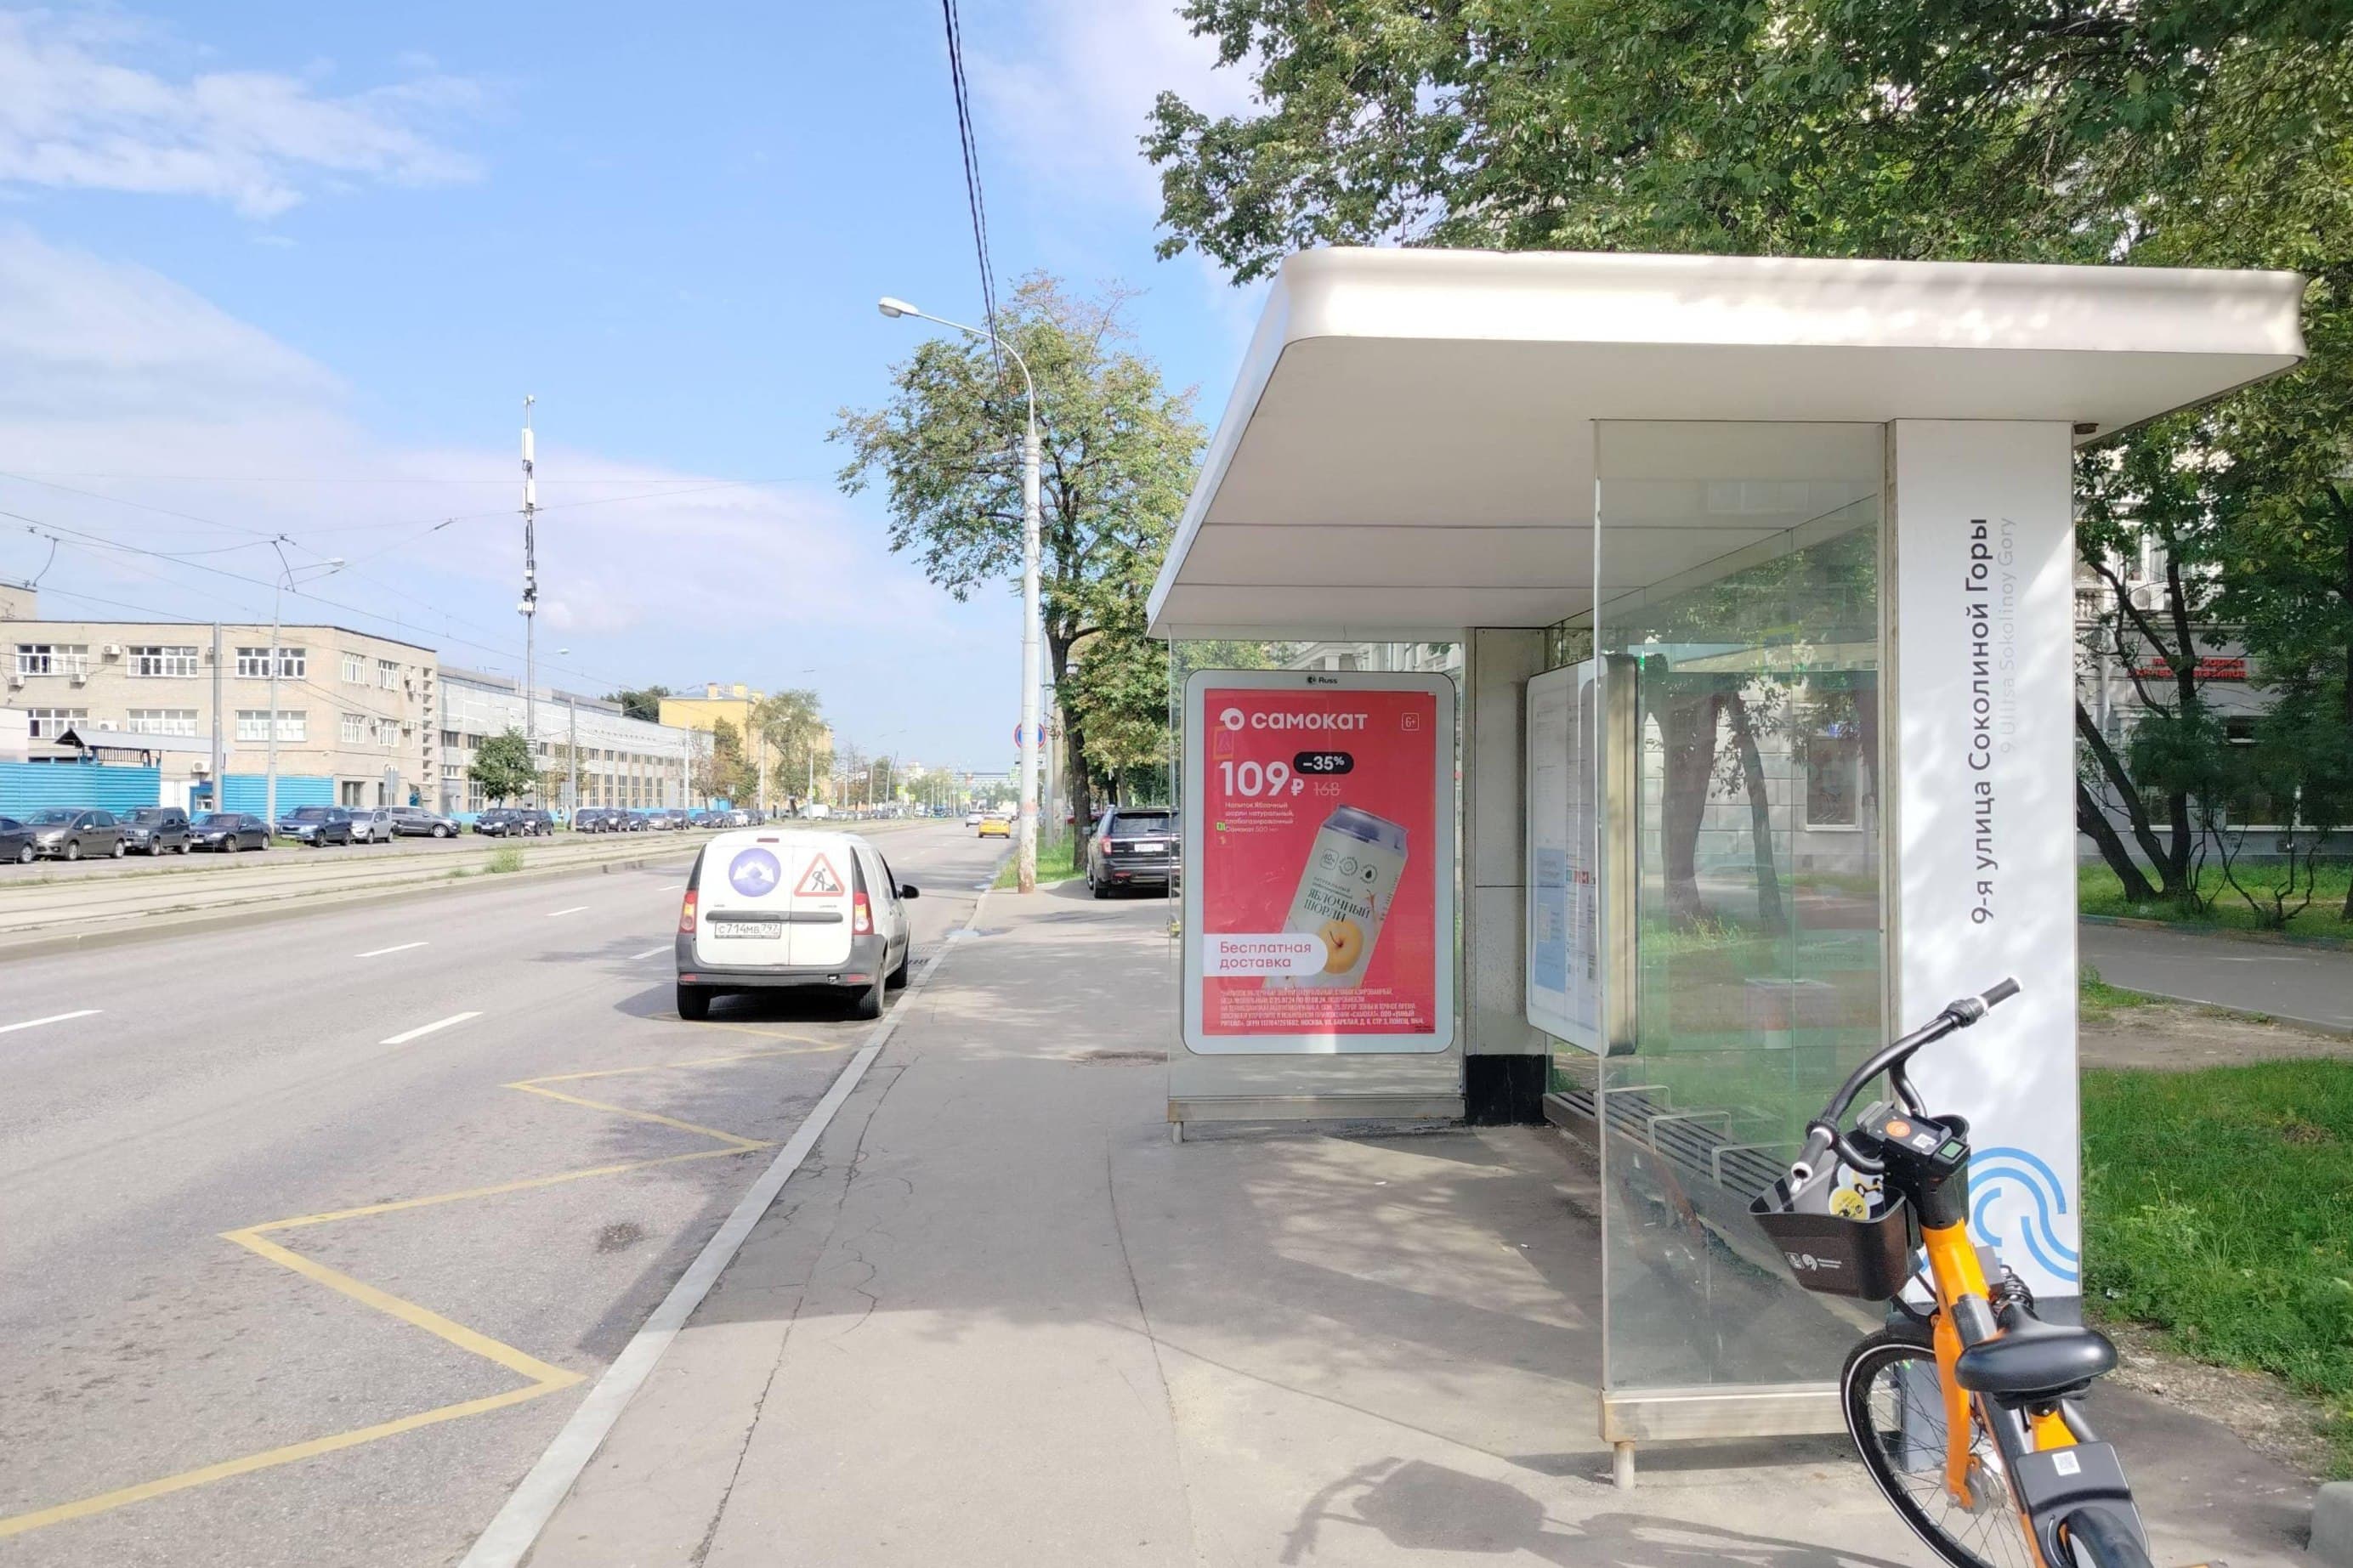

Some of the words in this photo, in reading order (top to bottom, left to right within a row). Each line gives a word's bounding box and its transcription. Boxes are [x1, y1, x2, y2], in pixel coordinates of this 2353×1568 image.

[1965, 518, 1993, 592] Горы
[1998, 518, 2017, 567] Gory
[1999, 572, 2017, 671] Sokolinoy
[1965, 603, 1991, 771] Соколиной
[1404, 716, 1417, 727] 6+
[1302, 756, 1346, 771] -35%
[1313, 782, 1341, 796] 168
[1974, 780, 1999, 871] улица
[1304, 898, 1347, 923] ШОРЛИ
[1308, 888, 1370, 919] ЯБЛОЧНЫЙ
[1970, 880, 1994, 925] 9-я
[1220, 941, 1312, 954] Бесплатная
[1219, 957, 1292, 970] доставка
